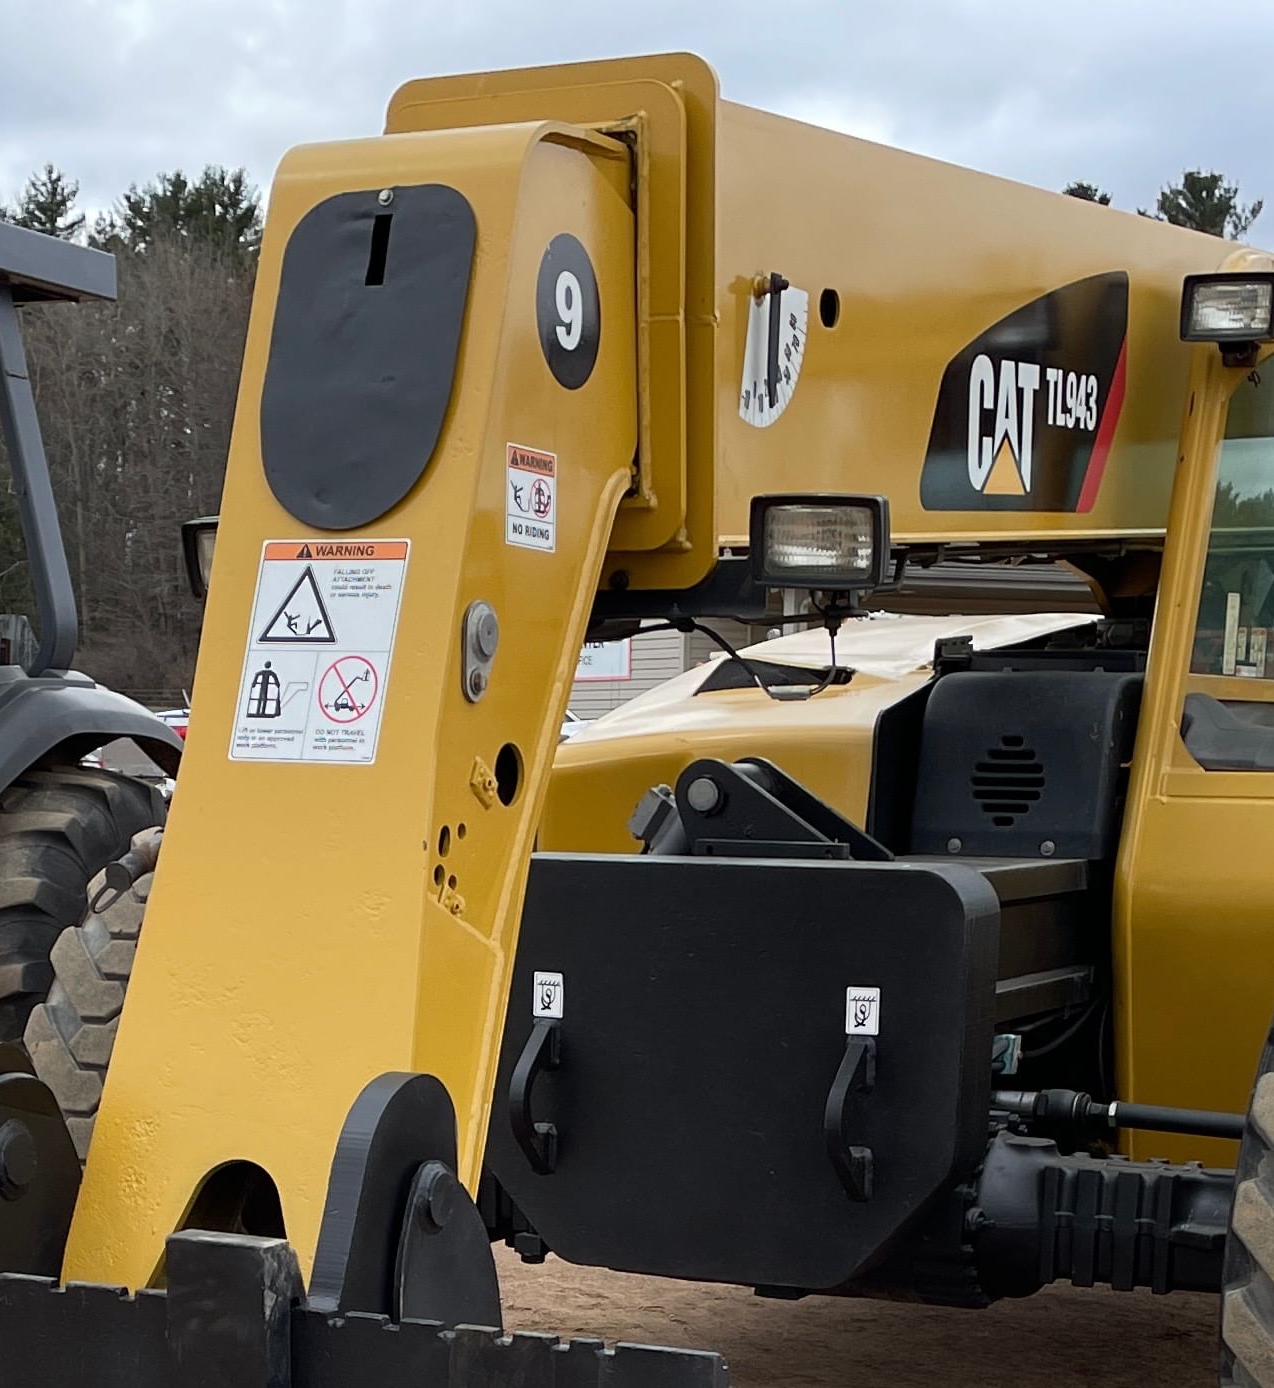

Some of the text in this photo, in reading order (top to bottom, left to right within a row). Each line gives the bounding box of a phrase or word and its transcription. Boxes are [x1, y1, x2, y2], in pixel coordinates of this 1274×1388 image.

[555, 270, 583, 351] 9
[967, 354, 1098, 493] CAT TL943
[518, 453, 553, 472] WARNING
[512, 523, 550, 540] NO RIDING
[316, 545, 375, 557] WARNING
